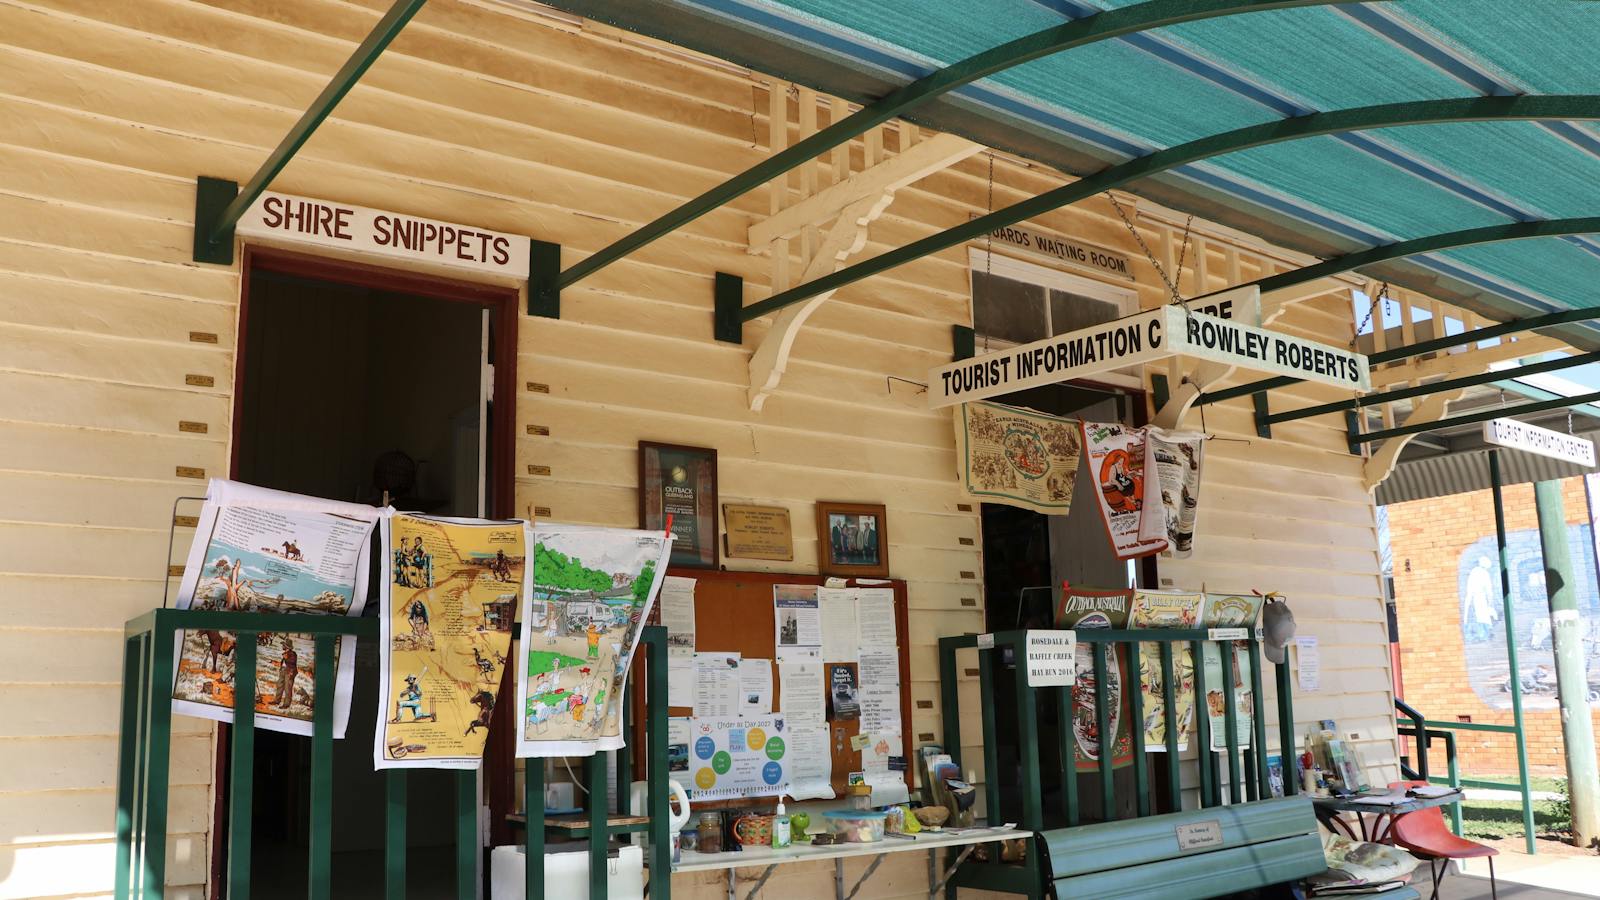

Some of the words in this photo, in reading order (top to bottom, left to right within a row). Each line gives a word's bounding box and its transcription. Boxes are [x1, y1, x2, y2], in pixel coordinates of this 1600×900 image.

[263, 197, 354, 241] SHIRE
[373, 215, 510, 265] SNIPPETS
[992, 228, 1031, 247] UARDS
[1035, 235, 1087, 262] WAITING
[1091, 252, 1127, 273] ROOM
[942, 356, 1011, 396] TOURIST
[1016, 323, 1142, 380] INFORMATION
[1186, 317, 1269, 361] ROWLEY
[1275, 339, 1359, 382] ROBERTS
[665, 486, 693, 494] OUTBACK
[1031, 638, 1063, 646] ROSEDALE
[717, 721, 736, 730] Under
